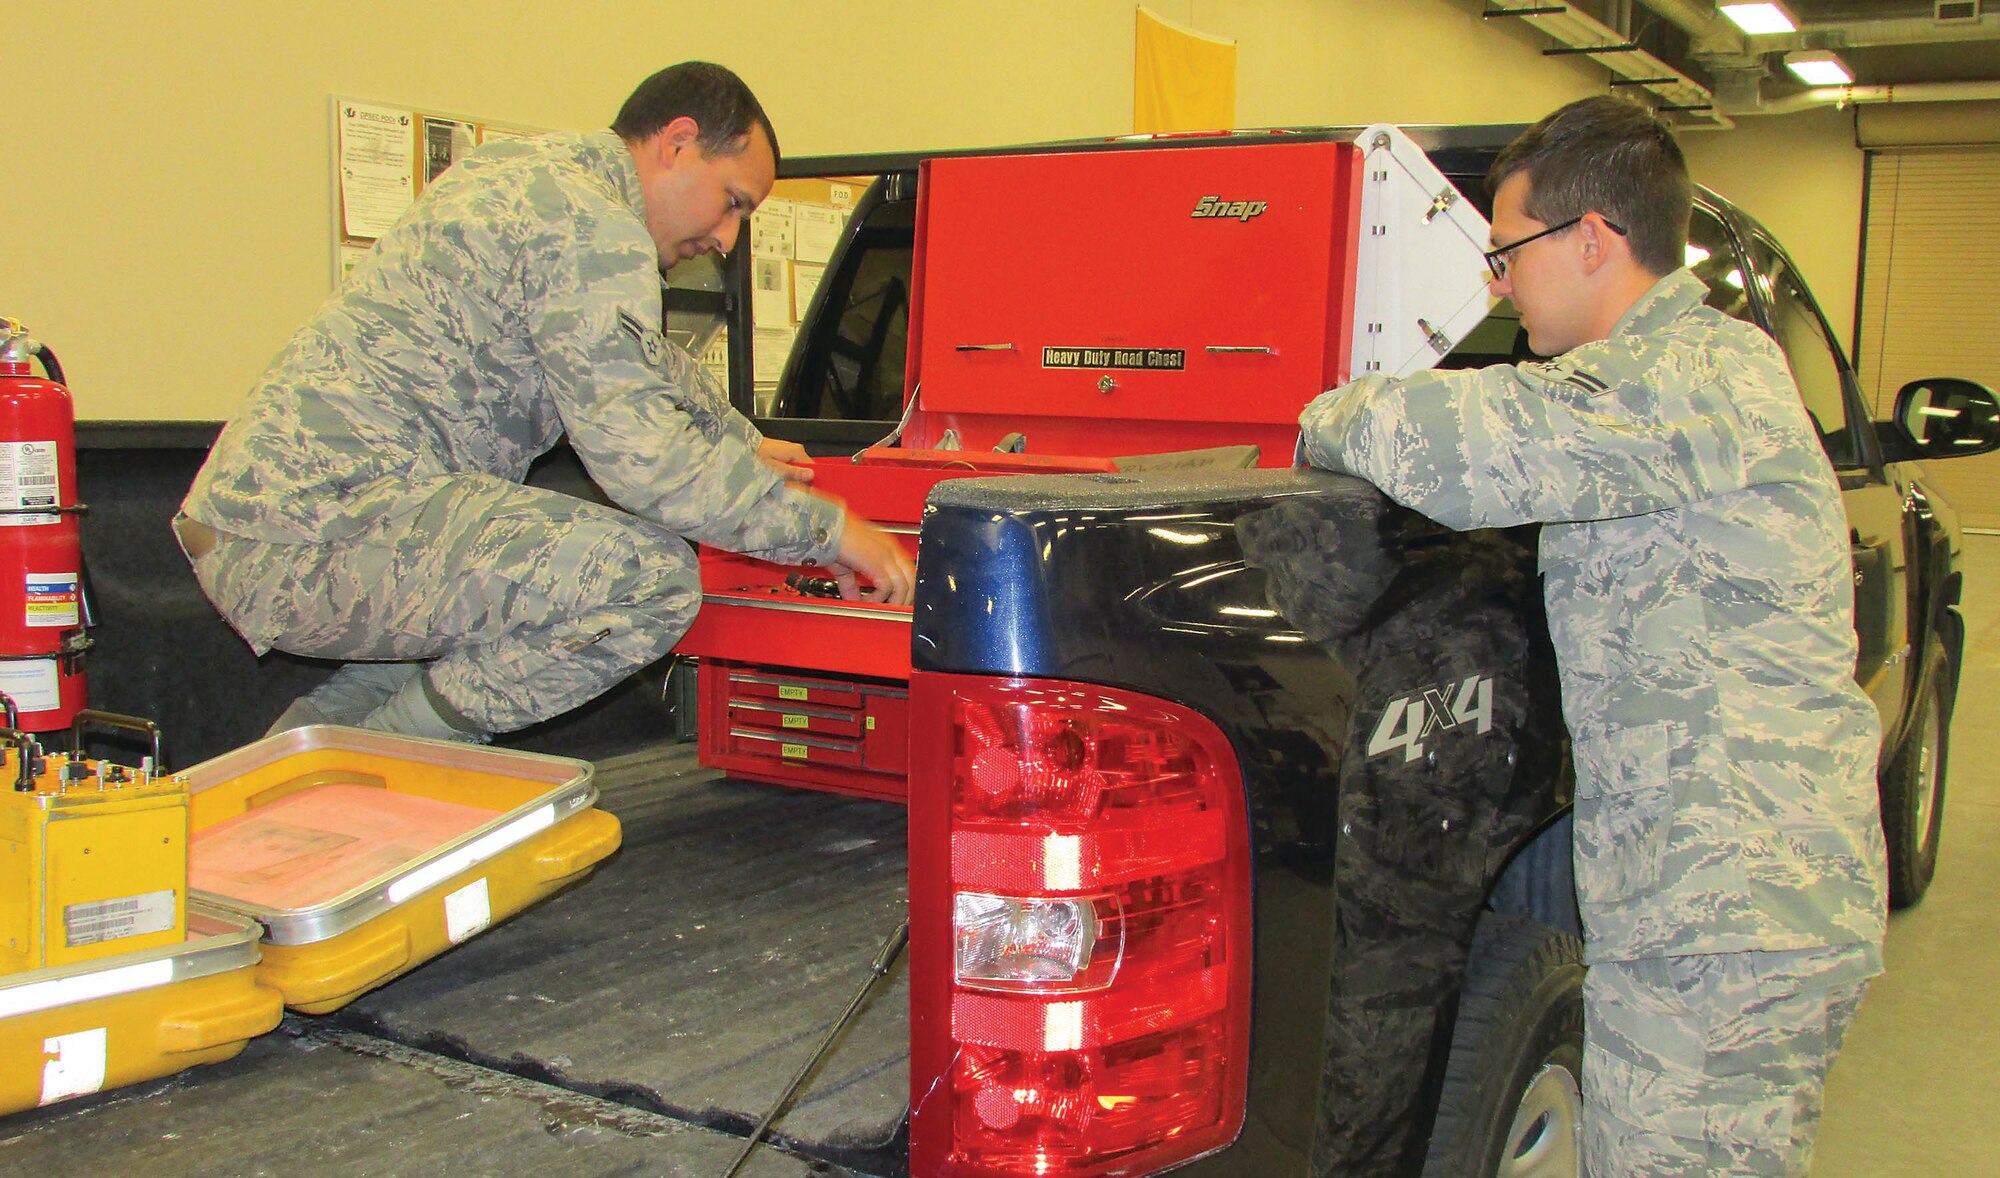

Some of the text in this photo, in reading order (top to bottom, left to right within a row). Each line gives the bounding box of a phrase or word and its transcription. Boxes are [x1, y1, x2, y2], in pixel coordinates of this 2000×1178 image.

[1045, 349, 1182, 367] Heavy Duty Road Chest
[780, 687, 803, 698] EMPTY
[783, 716, 807, 725] EMPTY
[783, 746, 806, 755] EMPTY
